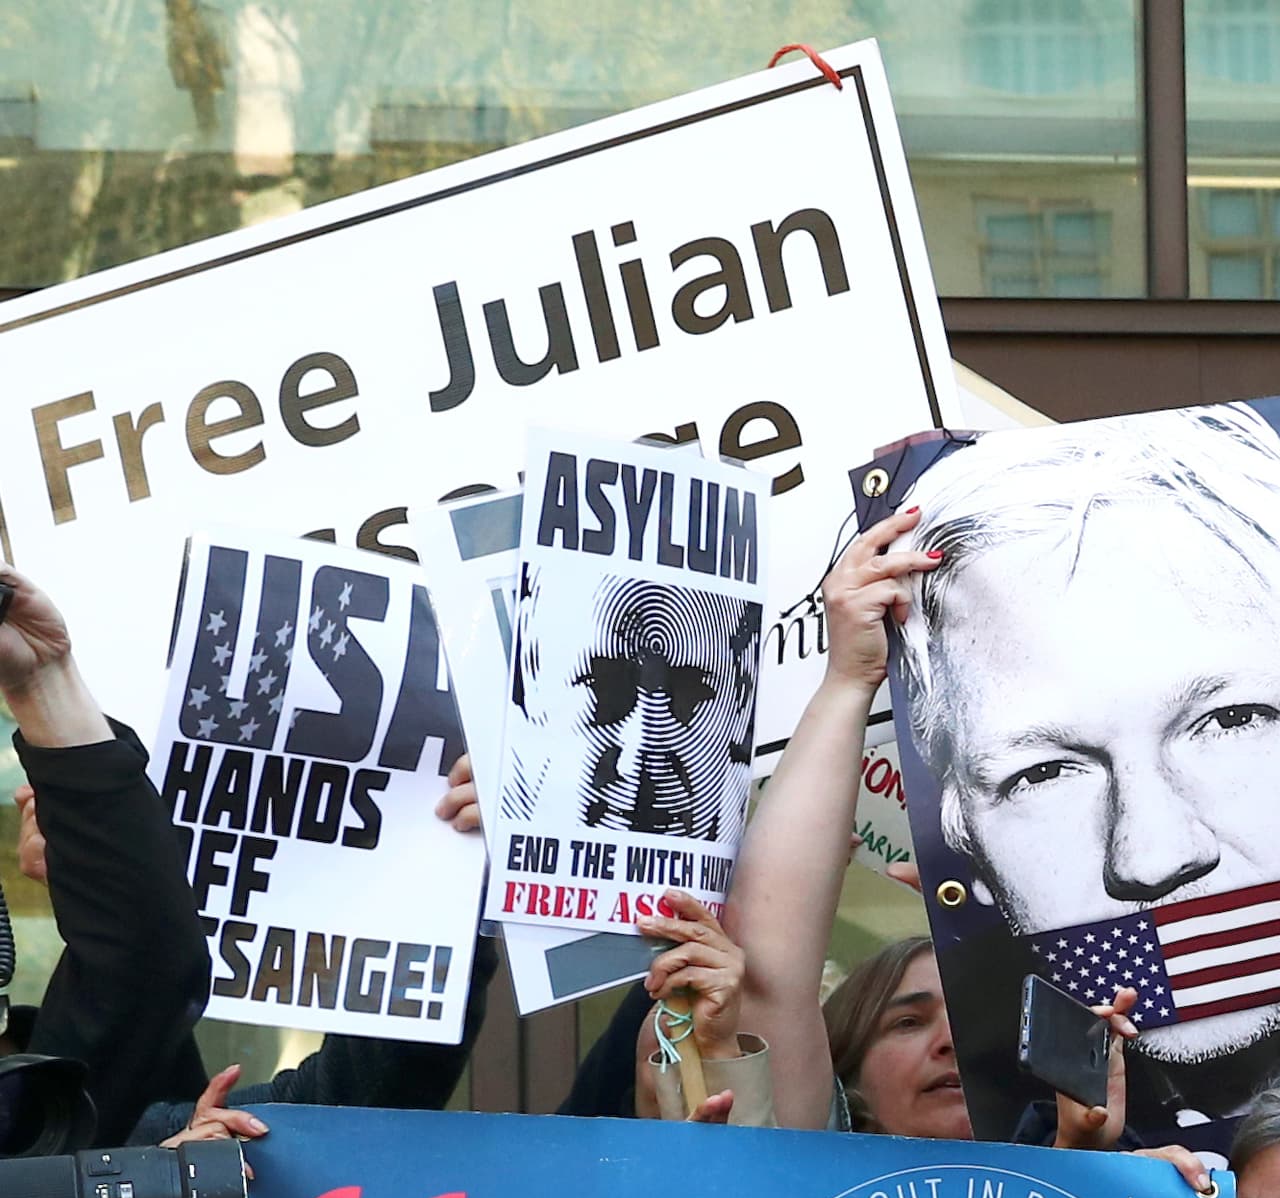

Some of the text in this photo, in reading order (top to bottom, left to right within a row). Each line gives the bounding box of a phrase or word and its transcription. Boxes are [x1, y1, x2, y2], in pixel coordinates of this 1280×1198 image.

[31, 352, 361, 524] Free
[429, 208, 850, 412] Julian
[537, 451, 758, 585] ASYLUM
[180, 546, 467, 776] USA
[162, 741, 391, 850] HANDS
[178, 826, 278, 917] FF
[502, 882, 598, 920] FREE
[507, 834, 559, 874] END
[570, 840, 617, 880] THE
[626, 846, 694, 888] WITCH
[199, 916, 453, 1020] SANGE!
